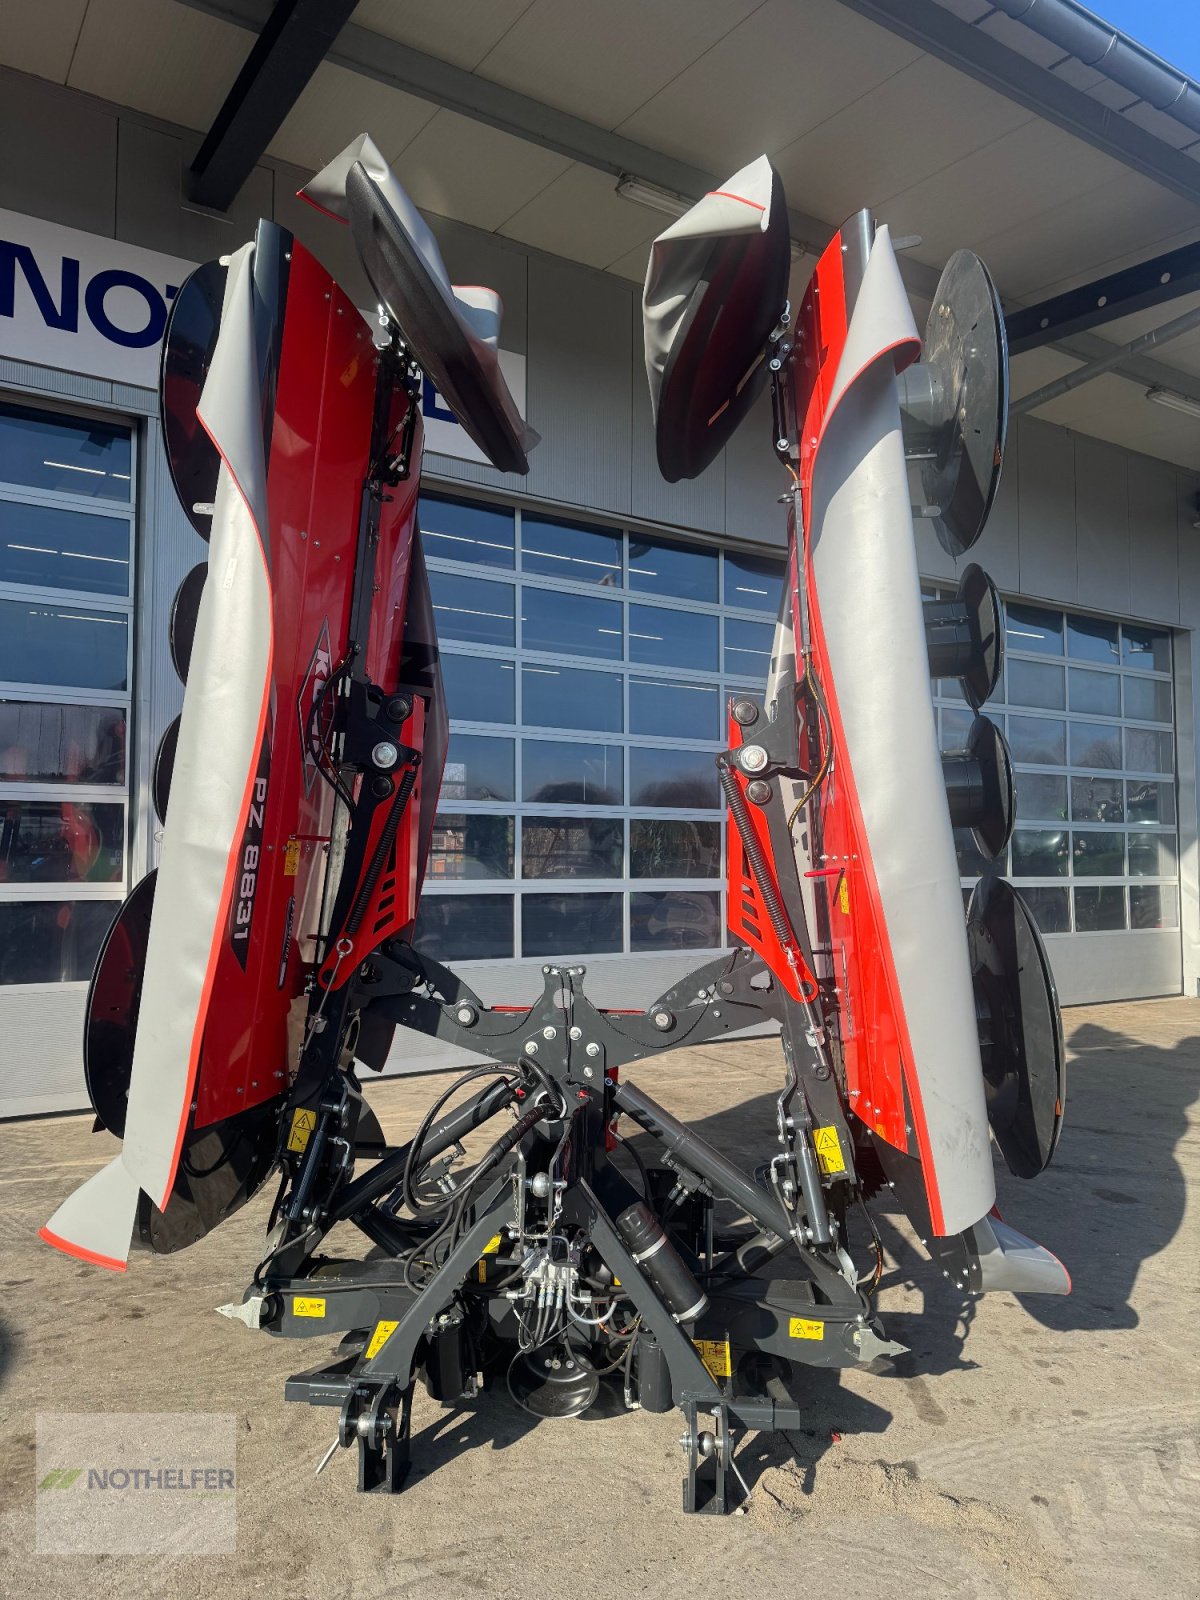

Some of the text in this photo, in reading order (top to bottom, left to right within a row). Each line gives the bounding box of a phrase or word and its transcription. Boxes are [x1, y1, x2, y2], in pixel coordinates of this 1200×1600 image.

[0, 240, 179, 348] NO
[234, 777, 267, 940] PZ 8831
